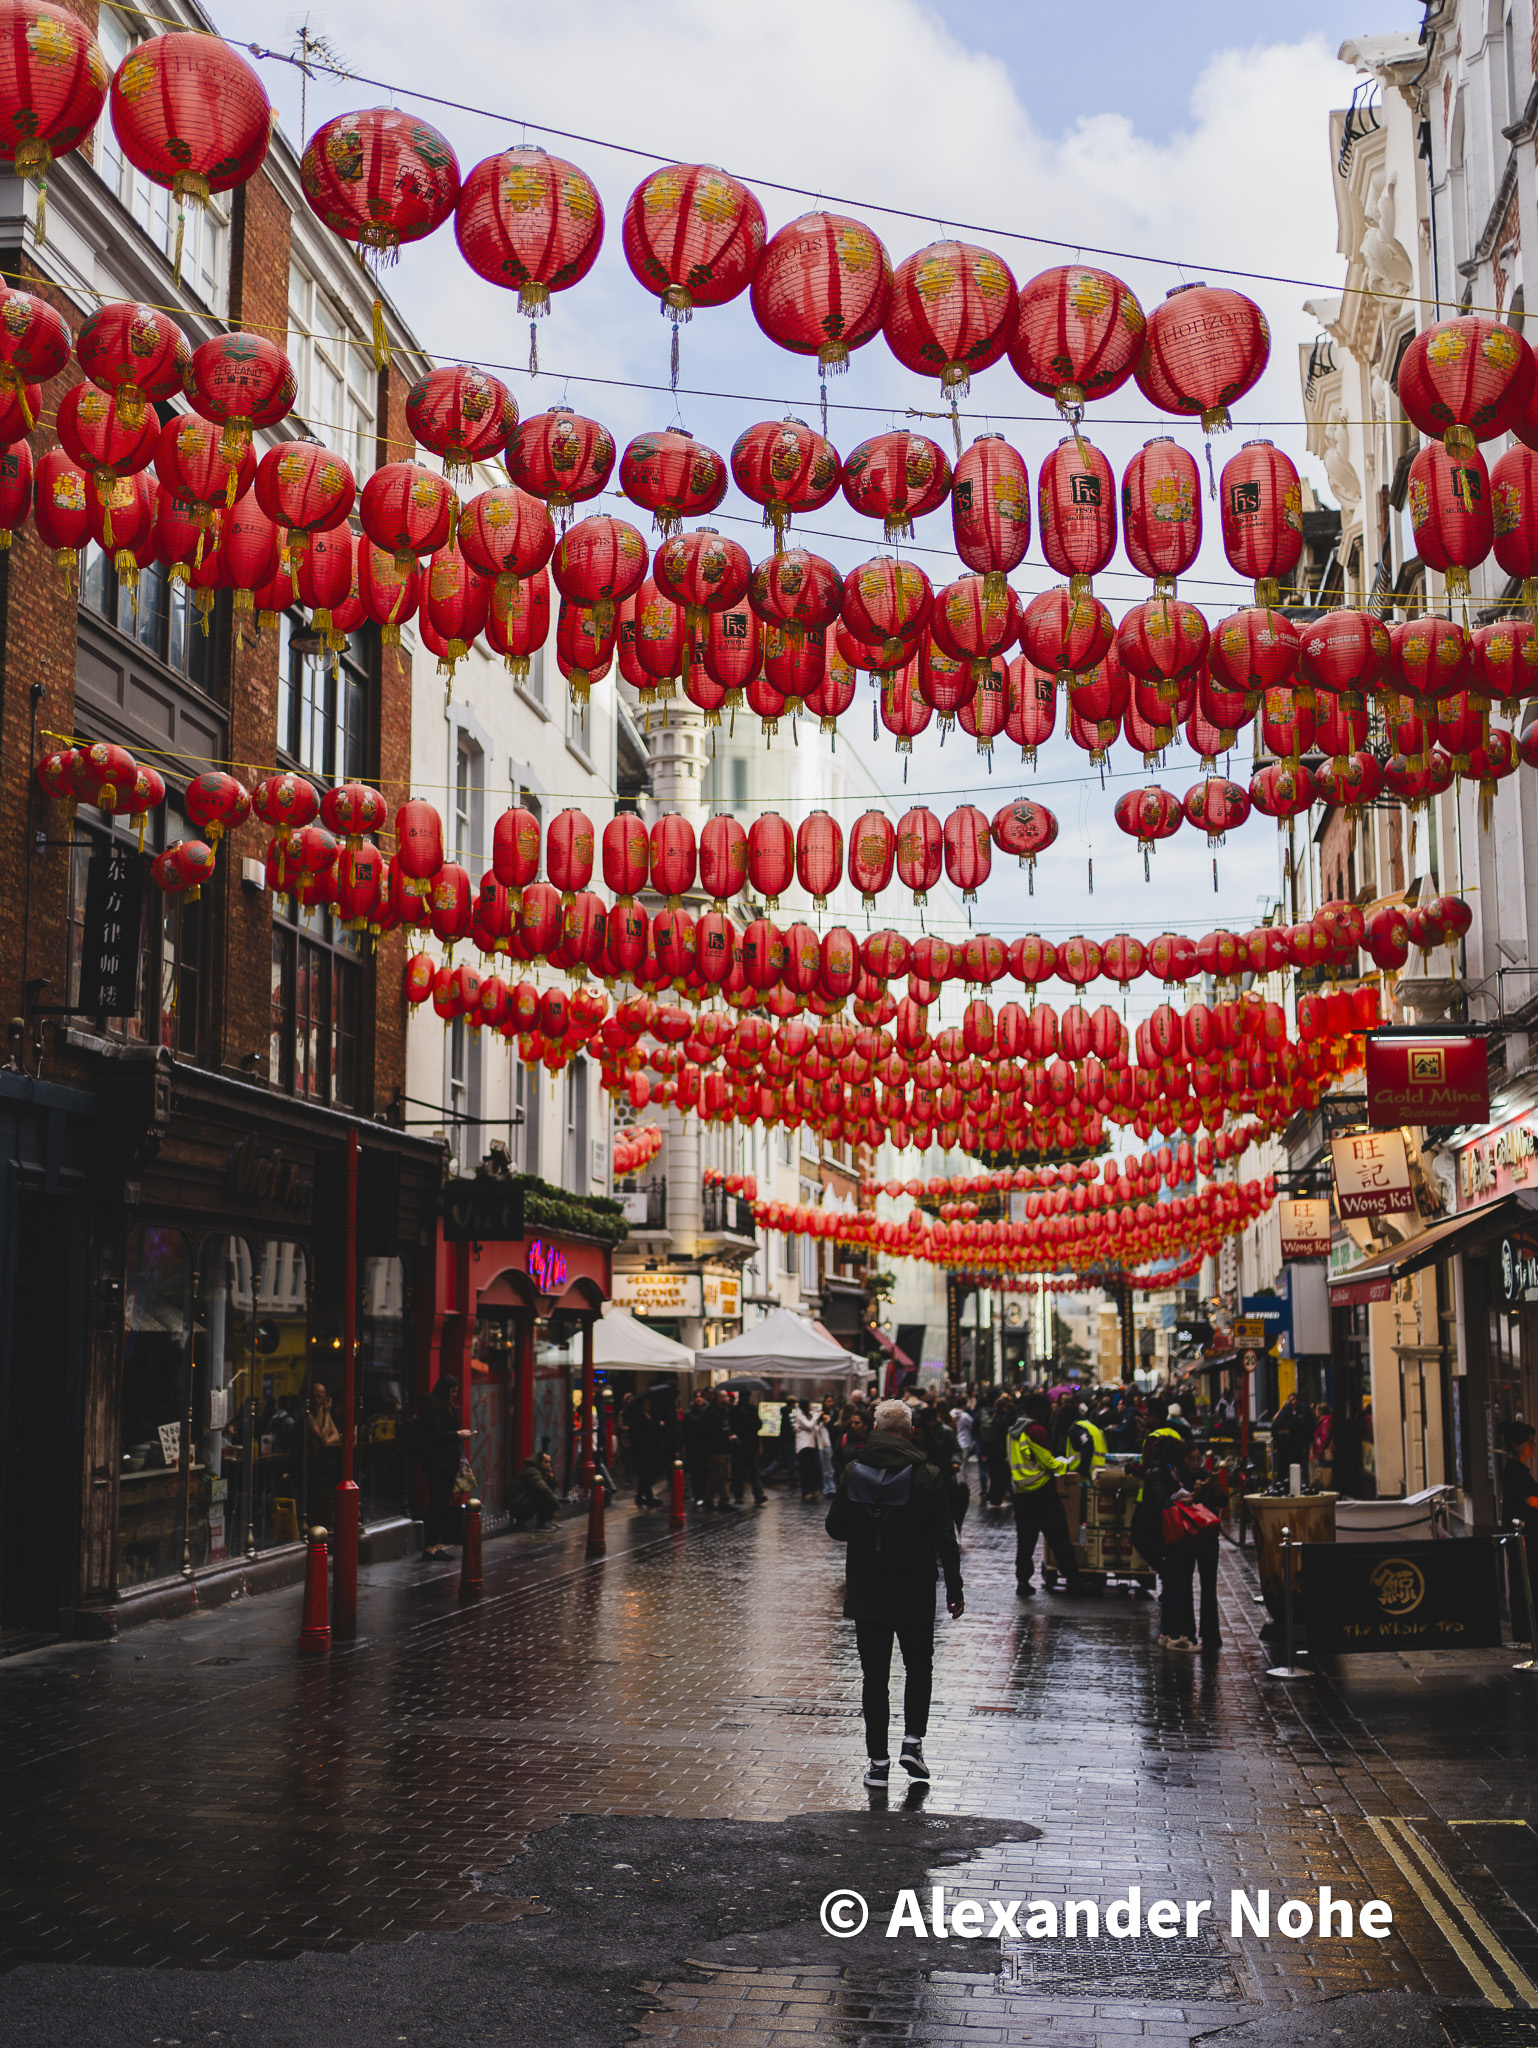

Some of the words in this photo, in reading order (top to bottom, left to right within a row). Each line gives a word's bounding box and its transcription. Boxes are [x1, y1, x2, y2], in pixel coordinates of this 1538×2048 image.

[98, 860, 126, 1006] 东方律师楼
[1374, 1088, 1424, 1104] Gold
[1428, 1088, 1483, 1104] Mine
[1398, 1106, 1460, 1118] Restaurant
[1352, 1137, 1390, 1188] 旺記
[1342, 1197, 1388, 1213] Wong
[1389, 1191, 1412, 1208] Kei
[1293, 1203, 1318, 1238] 旺記
[1282, 1241, 1314, 1255] Wong
[1315, 1239, 1330, 1251] Kei
[636, 1288, 680, 1297] CORNER
[612, 1298, 686, 1308] RESTAURANT
[1245, 1312, 1280, 1320] BETFRED
[1246, 1355, 1255, 1367] 20
[1374, 1568, 1417, 1606] 鯨
[1342, 1623, 1372, 1636] The
[1379, 1621, 1428, 1636] Whale
